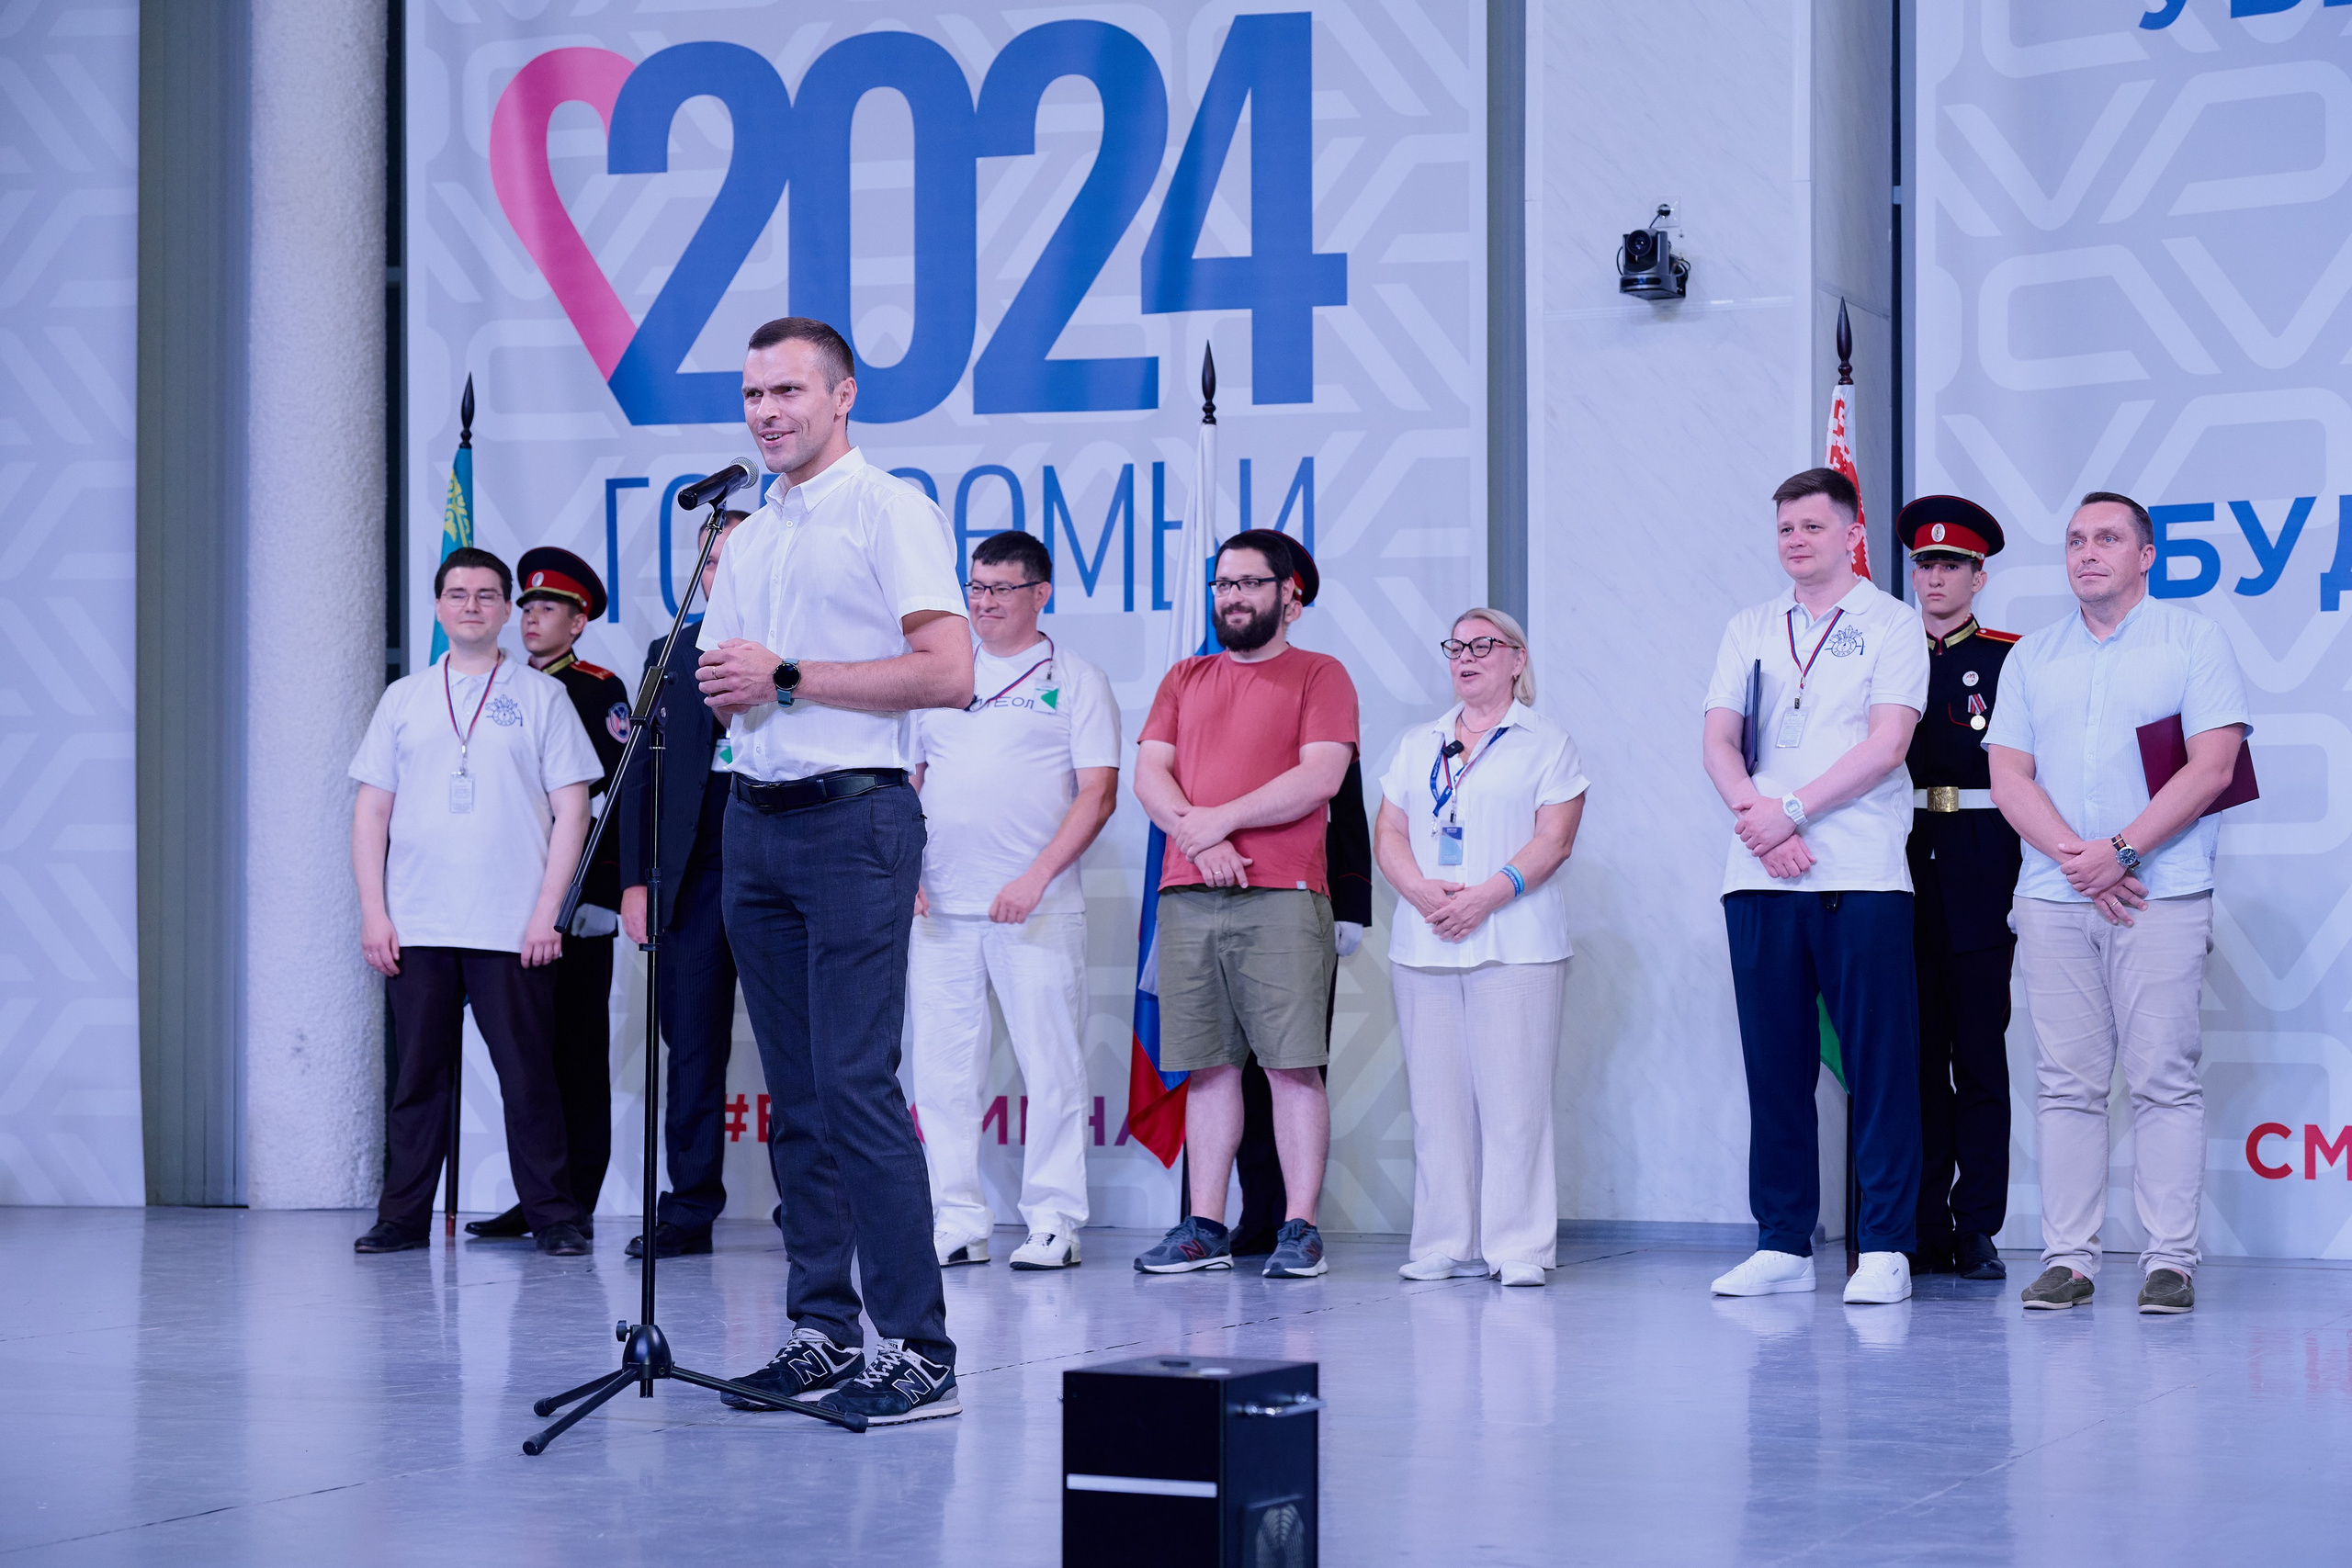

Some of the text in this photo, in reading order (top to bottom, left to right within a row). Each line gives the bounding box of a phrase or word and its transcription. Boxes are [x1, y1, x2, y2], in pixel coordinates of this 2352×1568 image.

[606, 12, 1348, 426] 2024
[605, 456, 1315, 624] ГО ЕМЬИ
[788, 1349, 828, 1385] N
[892, 1369, 931, 1404] N
